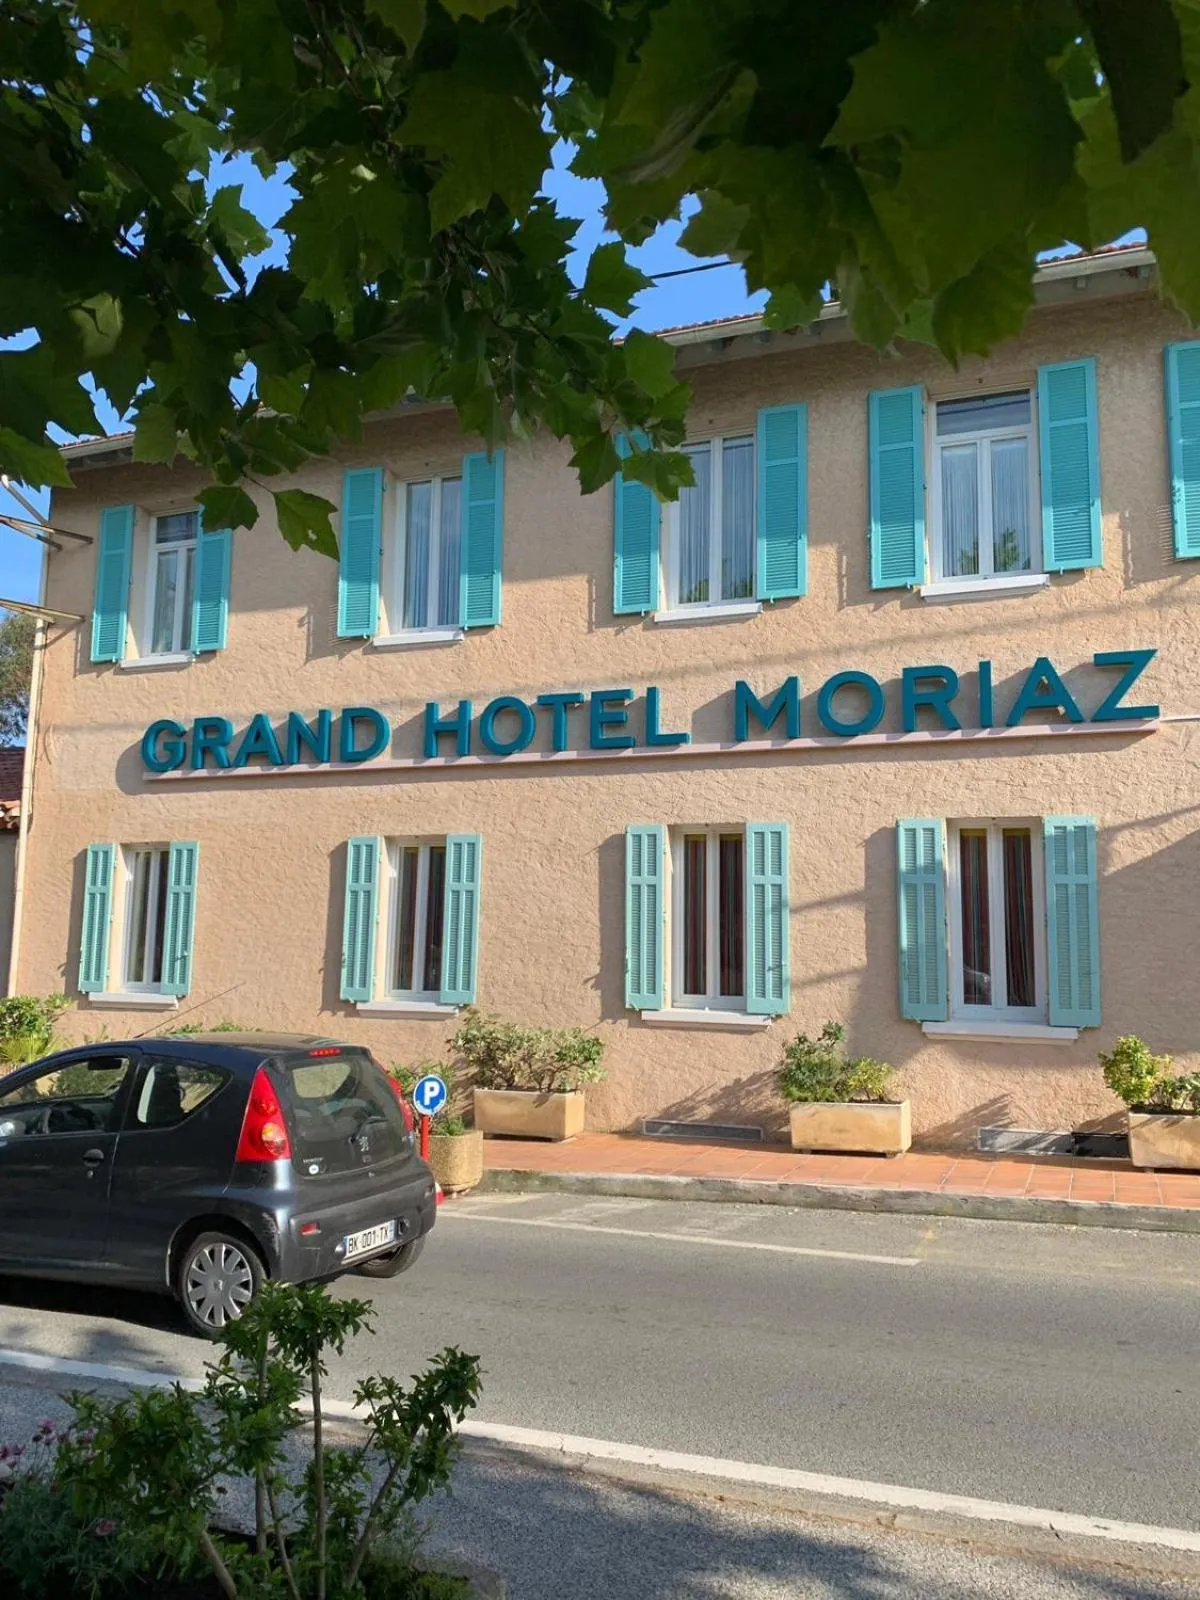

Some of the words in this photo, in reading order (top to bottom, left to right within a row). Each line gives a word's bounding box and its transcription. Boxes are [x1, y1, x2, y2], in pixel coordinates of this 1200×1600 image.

[141, 706, 391, 772] GRAND
[424, 687, 690, 759] HOTEL
[735, 649, 1160, 742] MORIAZ
[424, 1081, 440, 1105] P
